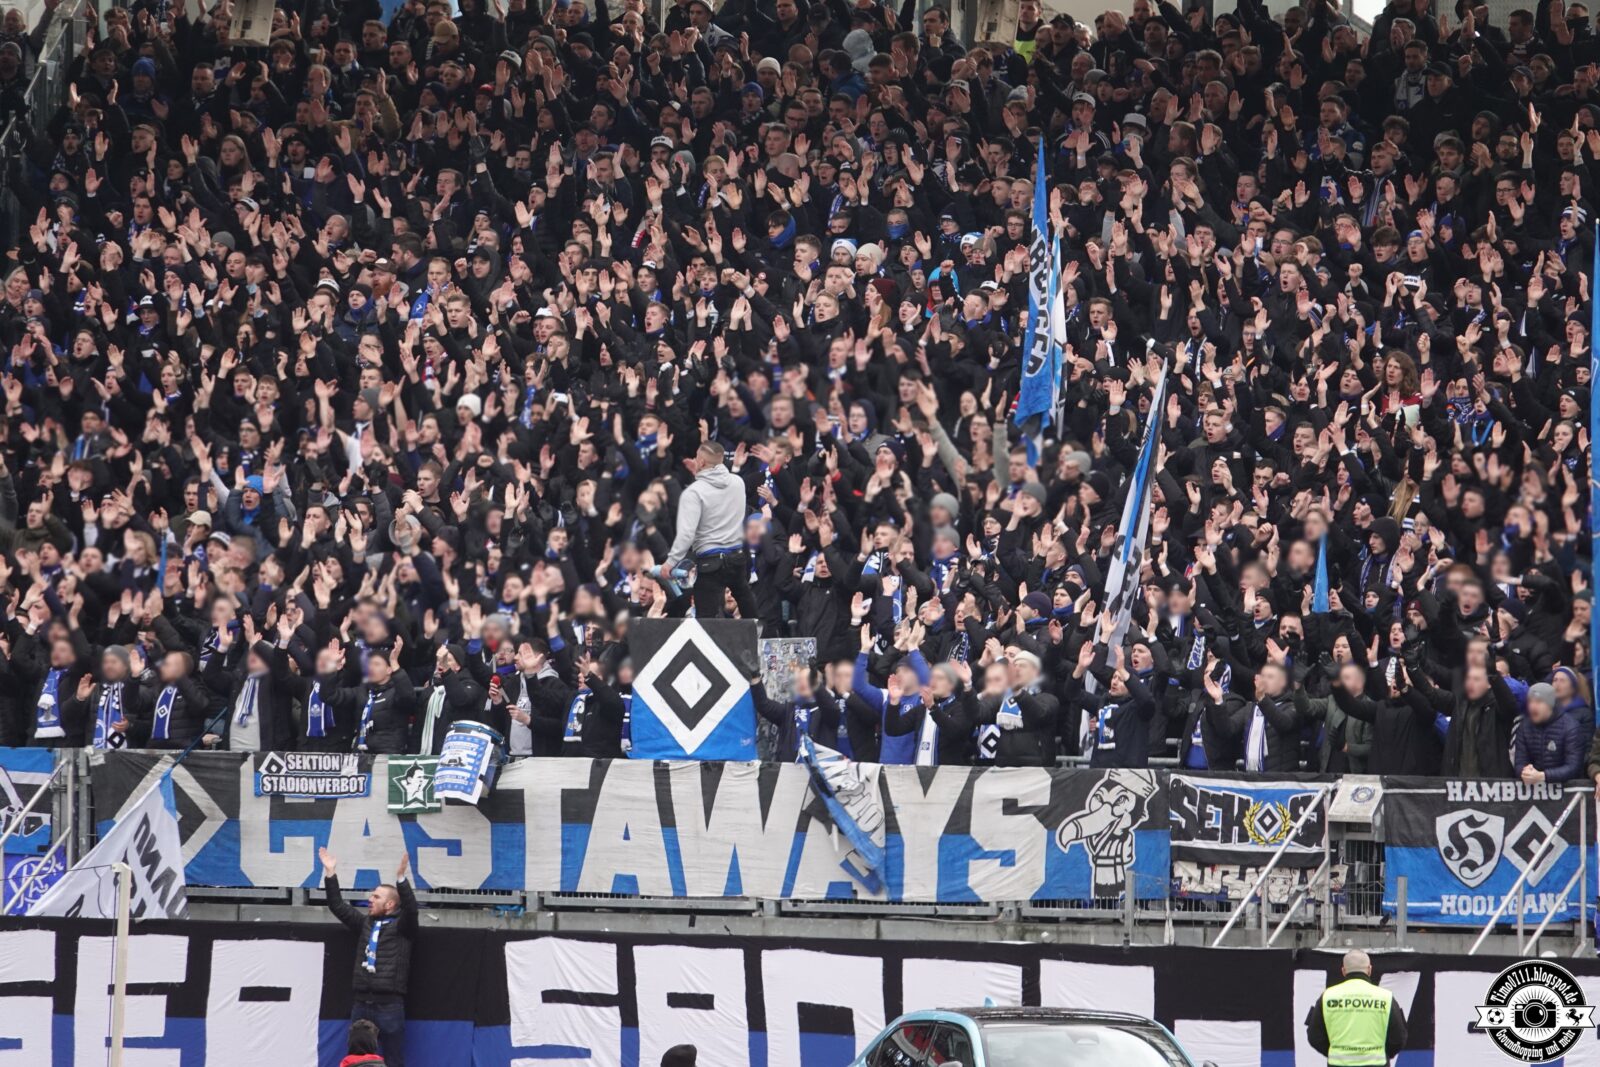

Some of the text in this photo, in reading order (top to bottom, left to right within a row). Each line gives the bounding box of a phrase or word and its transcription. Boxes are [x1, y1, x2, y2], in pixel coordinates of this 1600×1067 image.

[286, 754, 340, 771] SEKTION
[262, 775, 366, 794] STADIONVERBOT
[1446, 781, 1563, 802] HAMBURG
[1345, 999, 1387, 1010] POWER
